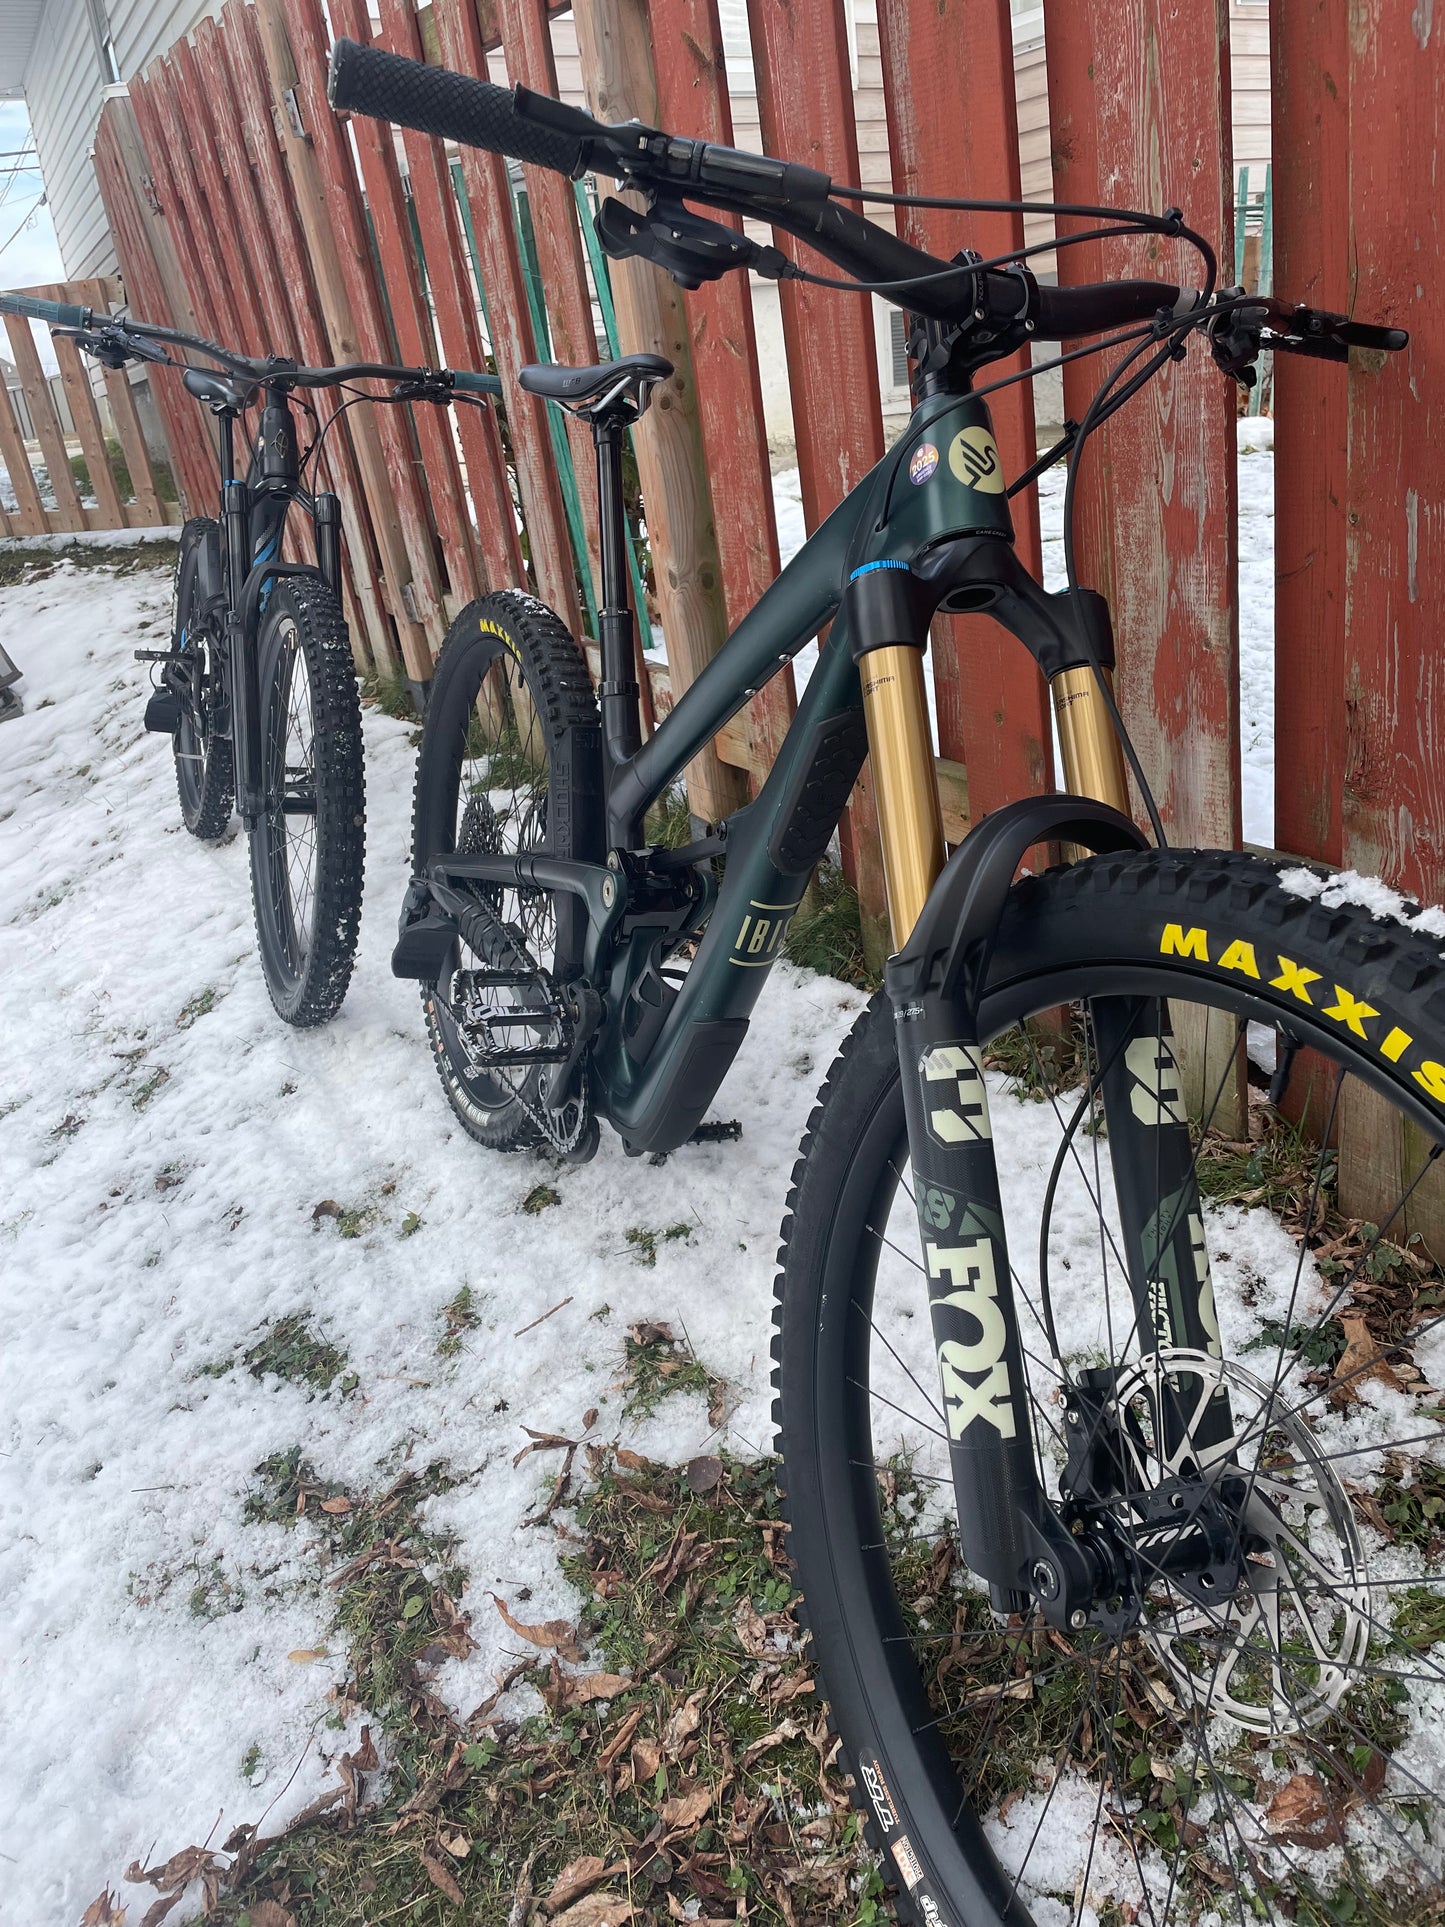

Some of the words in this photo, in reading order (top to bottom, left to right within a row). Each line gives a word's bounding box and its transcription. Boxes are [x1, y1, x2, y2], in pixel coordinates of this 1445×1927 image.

[911, 451, 935, 476] 2025
[480, 618, 522, 663] MAXXIS
[735, 914, 785, 951] IBI
[925, 1236, 1017, 1441] FOX
[861, 1764, 895, 1833] TLR
